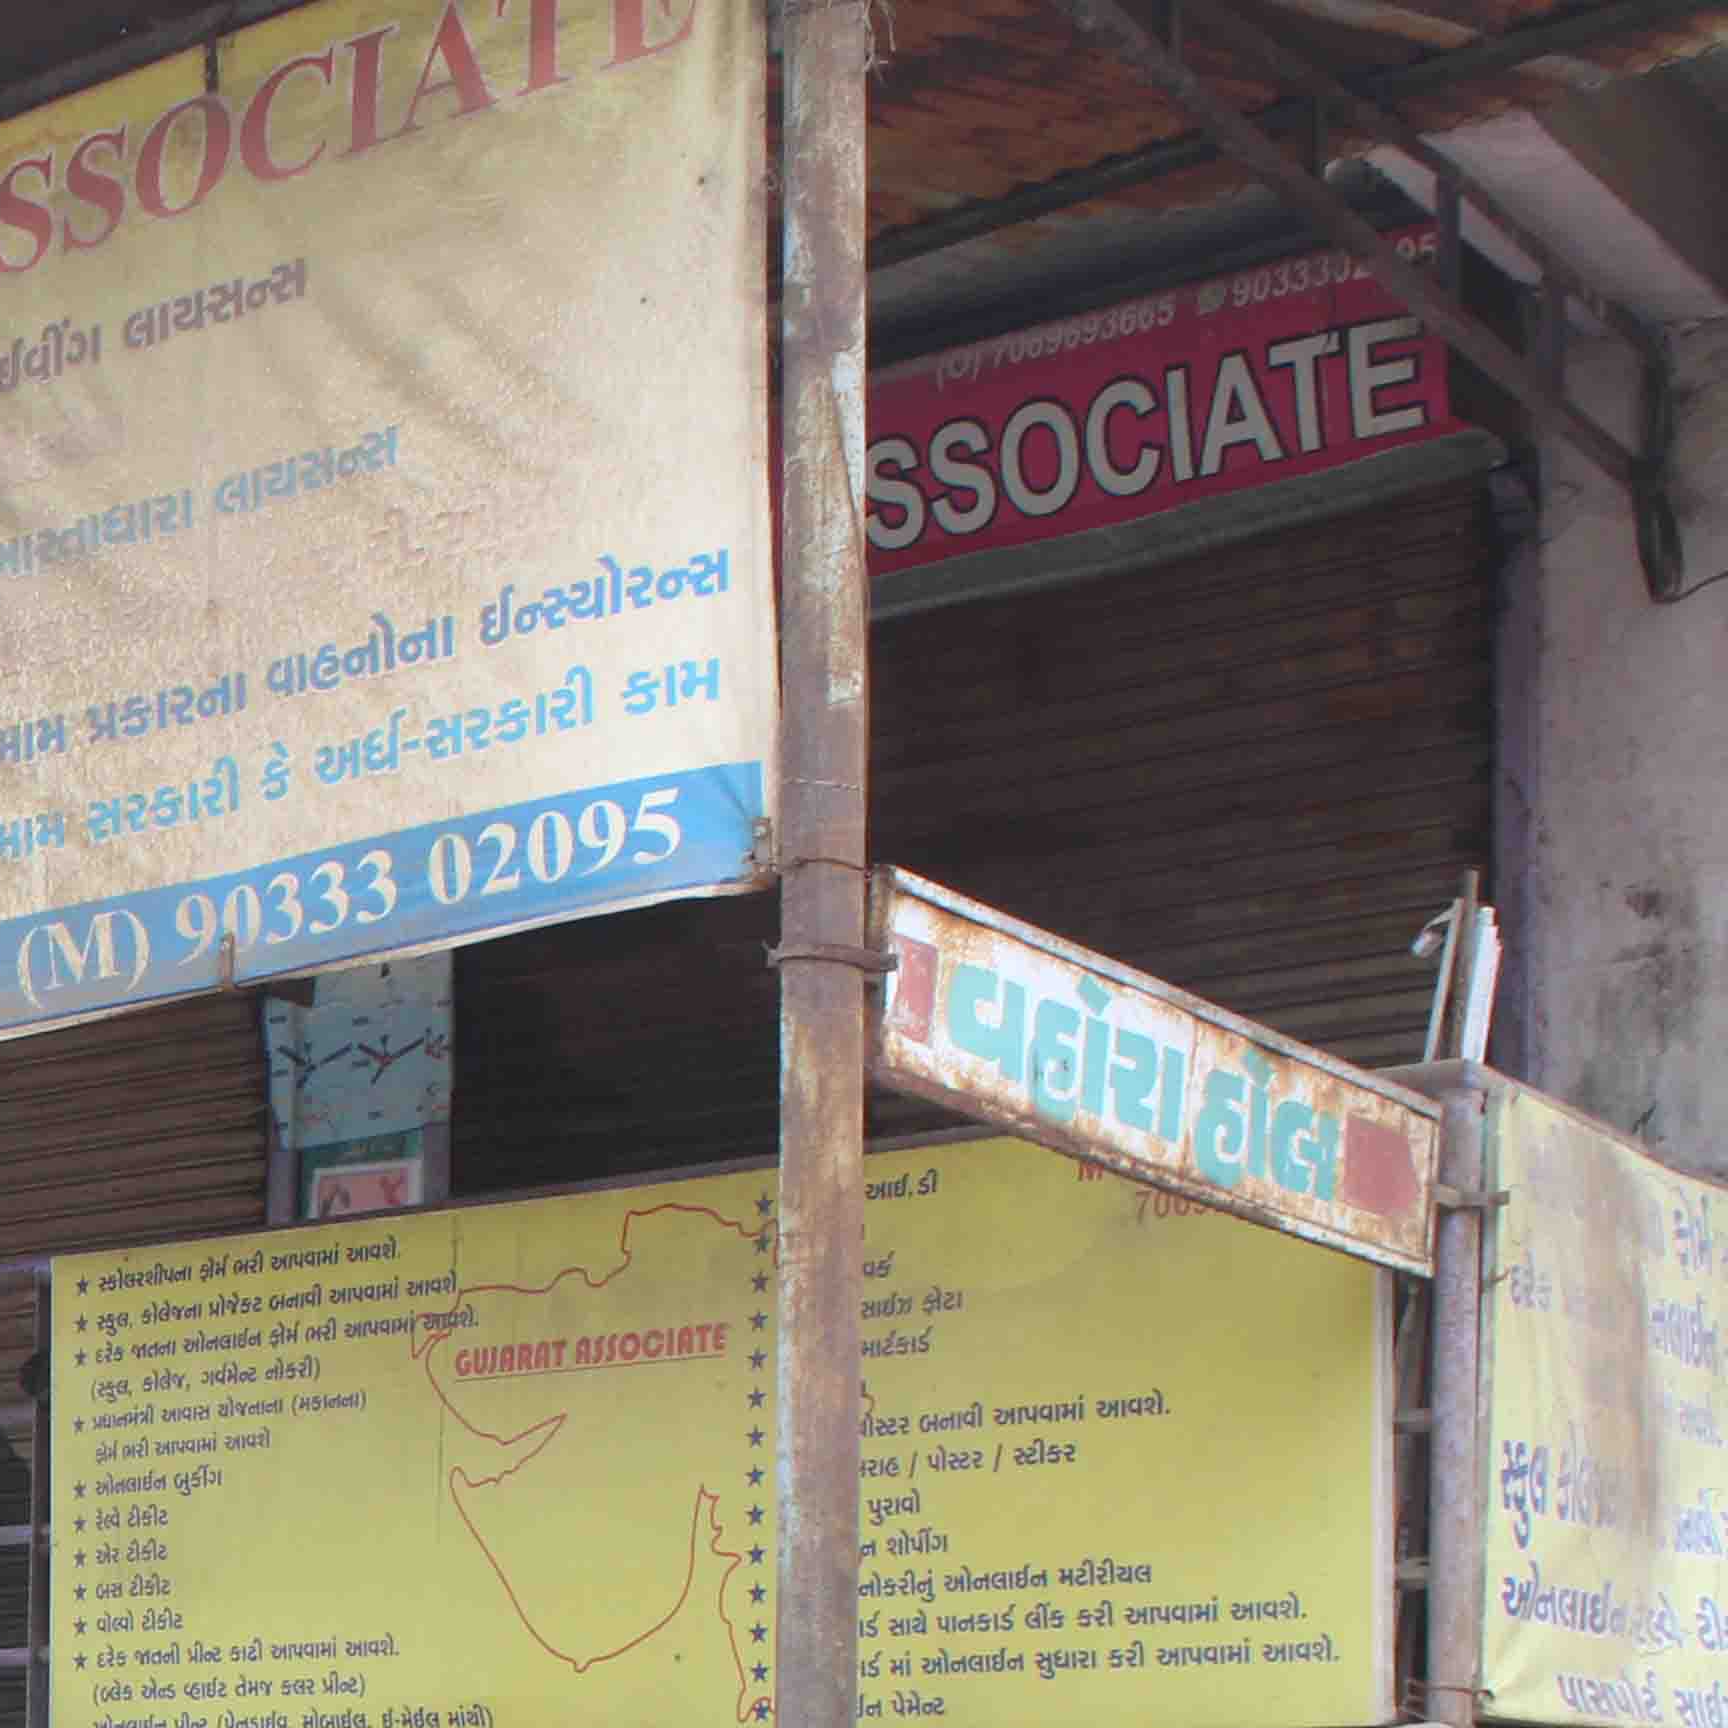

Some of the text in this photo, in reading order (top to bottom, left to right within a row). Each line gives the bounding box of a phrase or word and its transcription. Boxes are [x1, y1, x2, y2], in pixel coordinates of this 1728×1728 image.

[864, 315, 1432, 551] SSOCIATE
[267, 612, 454, 696] વાહનોના
[86, 753, 241, 842] સરકારી
[259, 747, 291, 801] કે
[622, 655, 721, 716] કામ
[19, 908, 150, 1010] (M)
[175, 847, 398, 970] 90333
[428, 787, 683, 906] 02095
[453, 1322, 732, 1378] GUJARAT ASSOCIATE
[861, 1326, 934, 1359] માર્ટકાર્ડ
[993, 1394, 1085, 1426] આપવામાં
[1076, 1599, 1114, 1628] કરી
[1124, 1595, 1218, 1626] આપવામાં
[1107, 1640, 1145, 1669] કરી
[1156, 1636, 1252, 1666] આપવામાં
